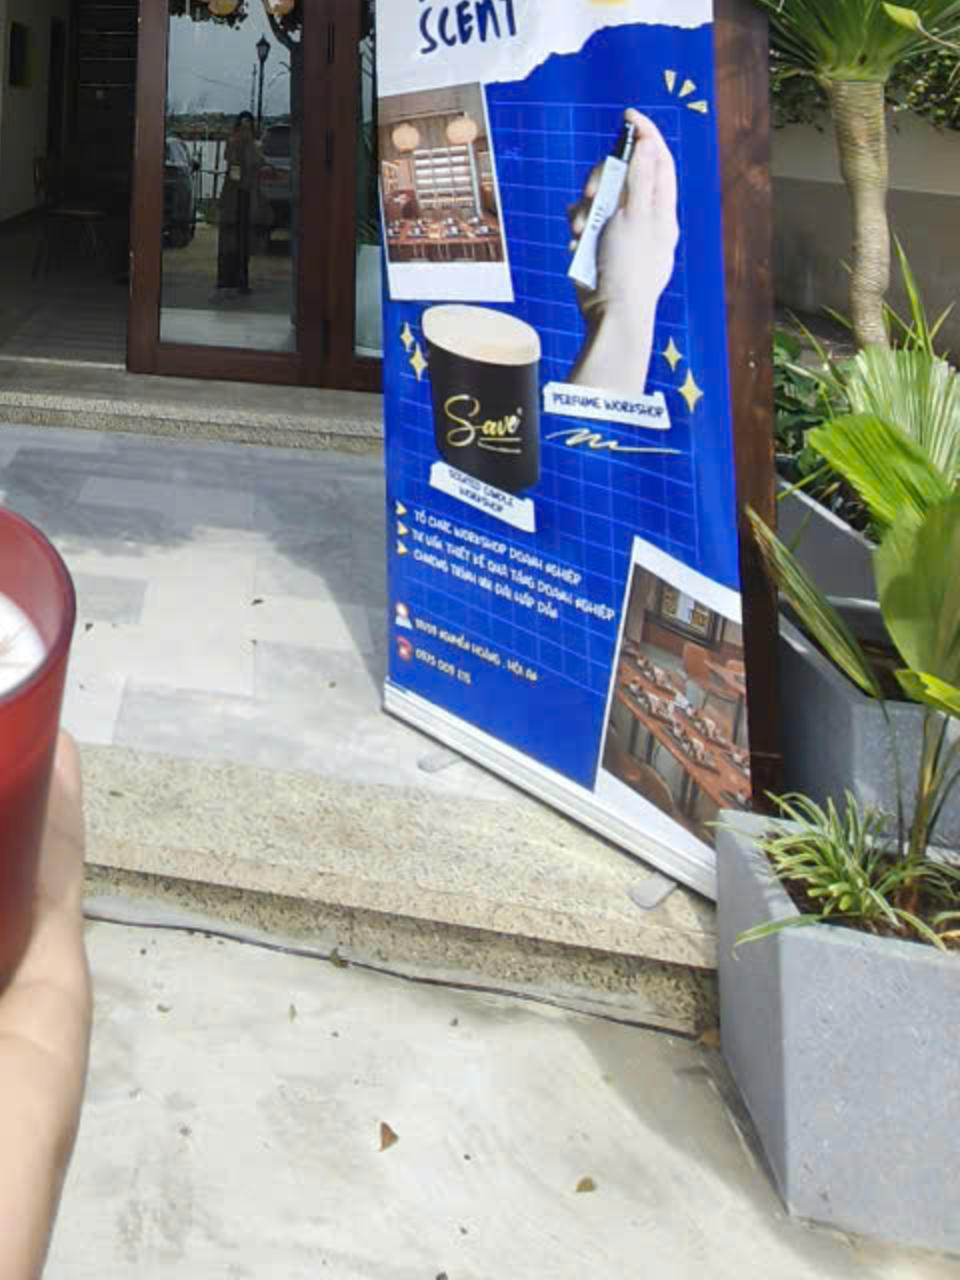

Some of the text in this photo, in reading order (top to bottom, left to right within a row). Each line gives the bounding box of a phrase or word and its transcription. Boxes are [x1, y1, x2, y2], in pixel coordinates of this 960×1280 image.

[444, 394, 521, 447] Save
[552, 393, 664, 417] PERFUME WORKSHOP
[452, 526, 507, 554] WORKSHOP
[509, 546, 543, 570] DOANH
[537, 579, 573, 604] DOANH
